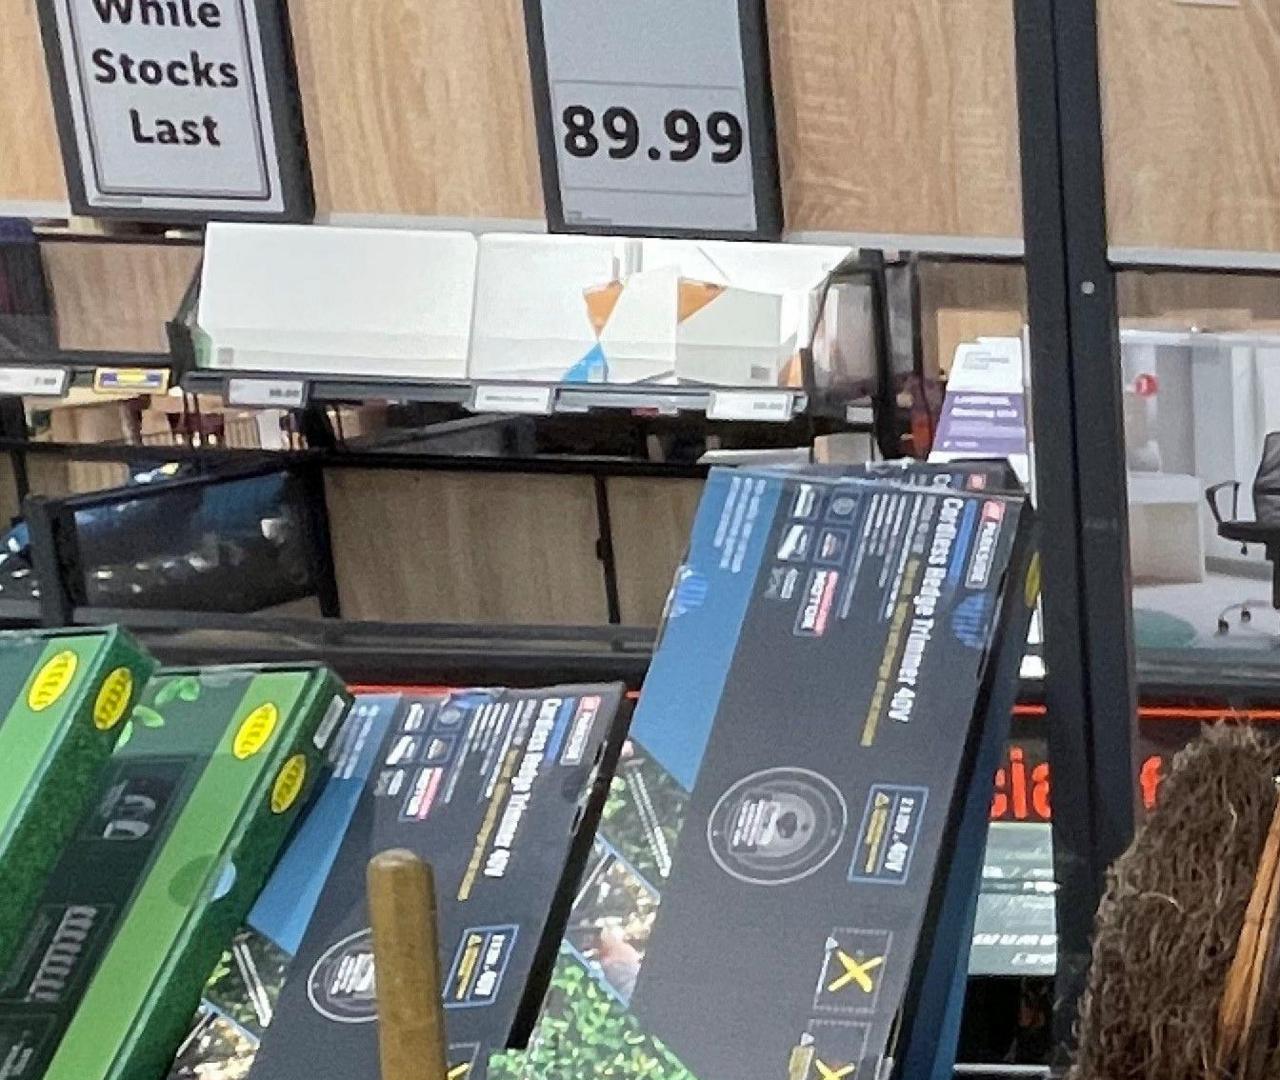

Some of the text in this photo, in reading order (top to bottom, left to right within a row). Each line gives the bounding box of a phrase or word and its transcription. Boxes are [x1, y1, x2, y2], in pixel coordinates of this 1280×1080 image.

[92, 0, 221, 28] While
[92, 47, 239, 88] Stocks
[129, 108, 221, 147] Last
[562, 104, 743, 164] 89.99
